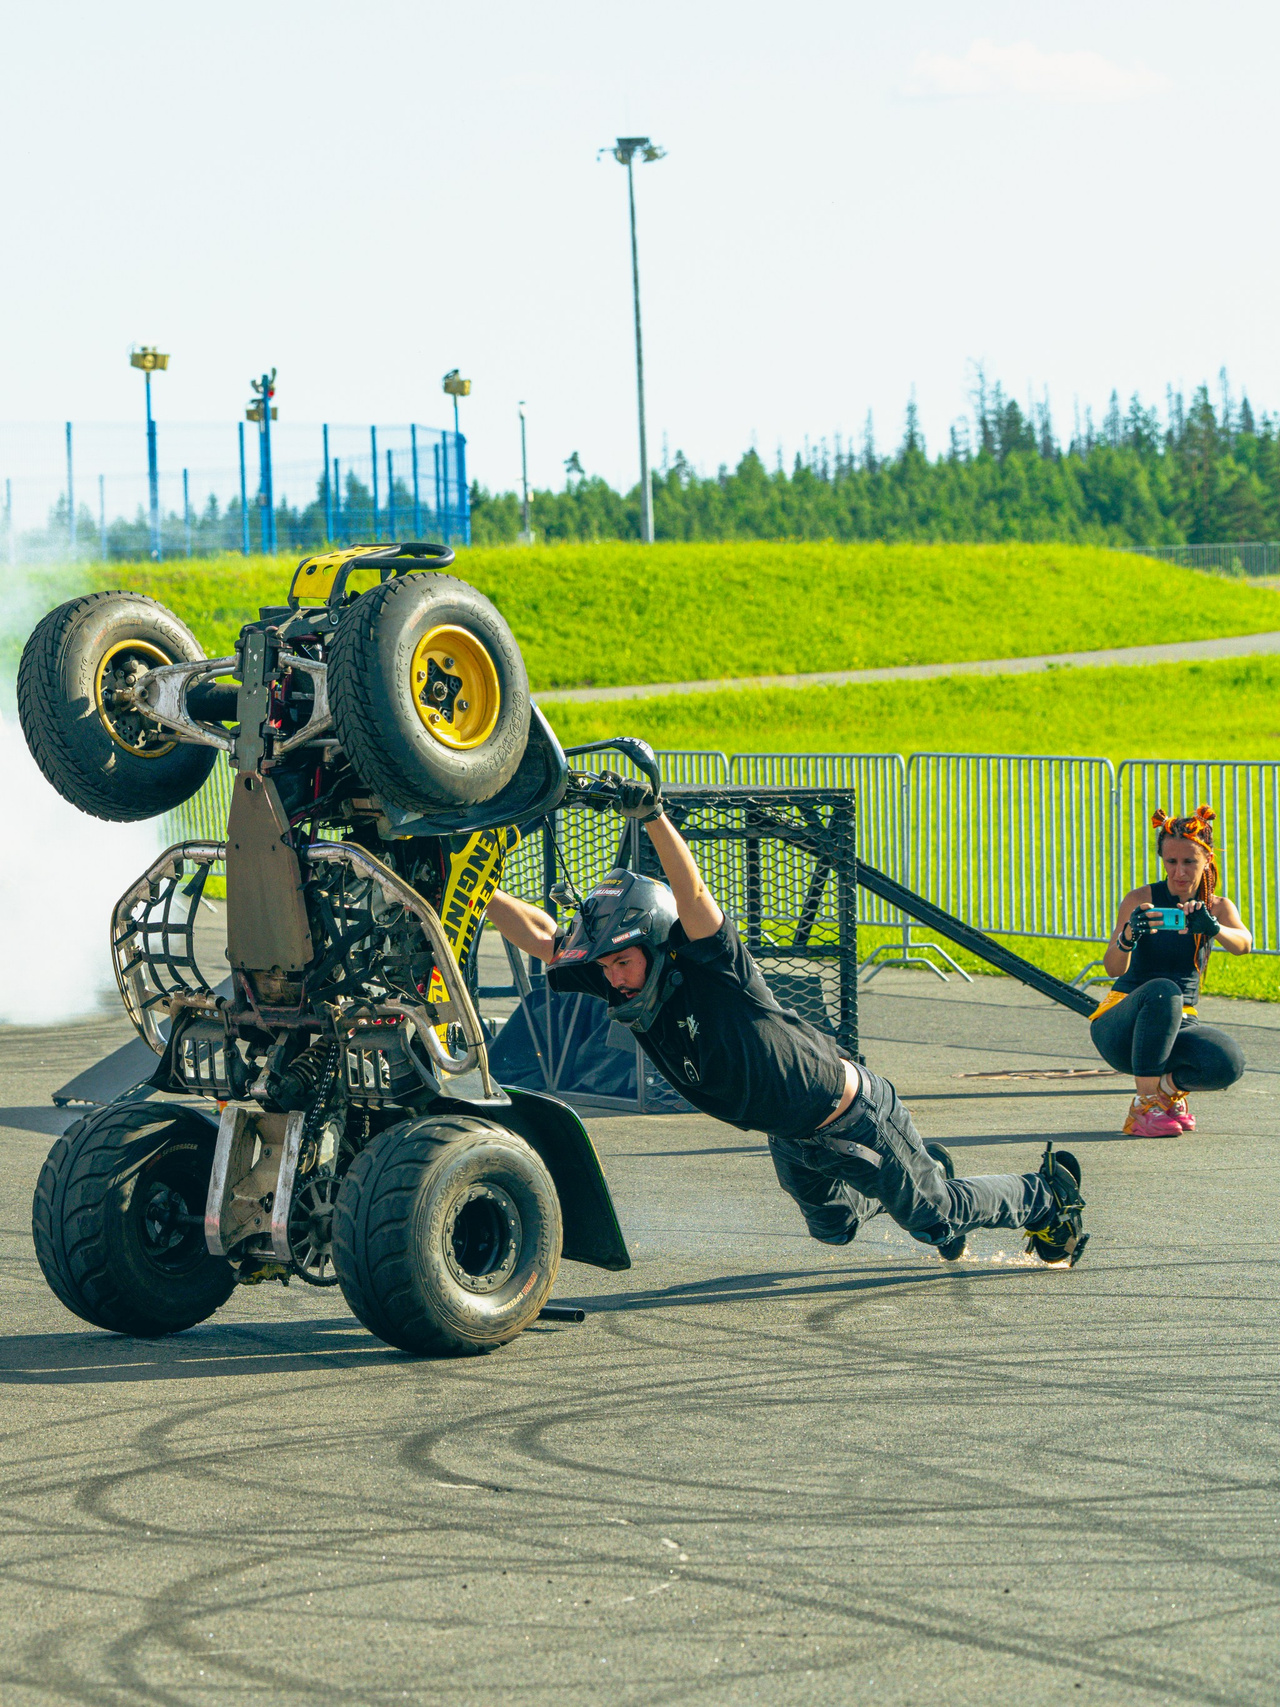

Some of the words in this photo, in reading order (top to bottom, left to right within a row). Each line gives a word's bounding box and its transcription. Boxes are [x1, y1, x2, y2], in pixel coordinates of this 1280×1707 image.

[152, 617, 196, 662] KEN
[470, 603, 518, 676] KENDA
[521, 1270, 538, 1295] KENDA
[490, 1291, 524, 1316] SPEEDRACER
